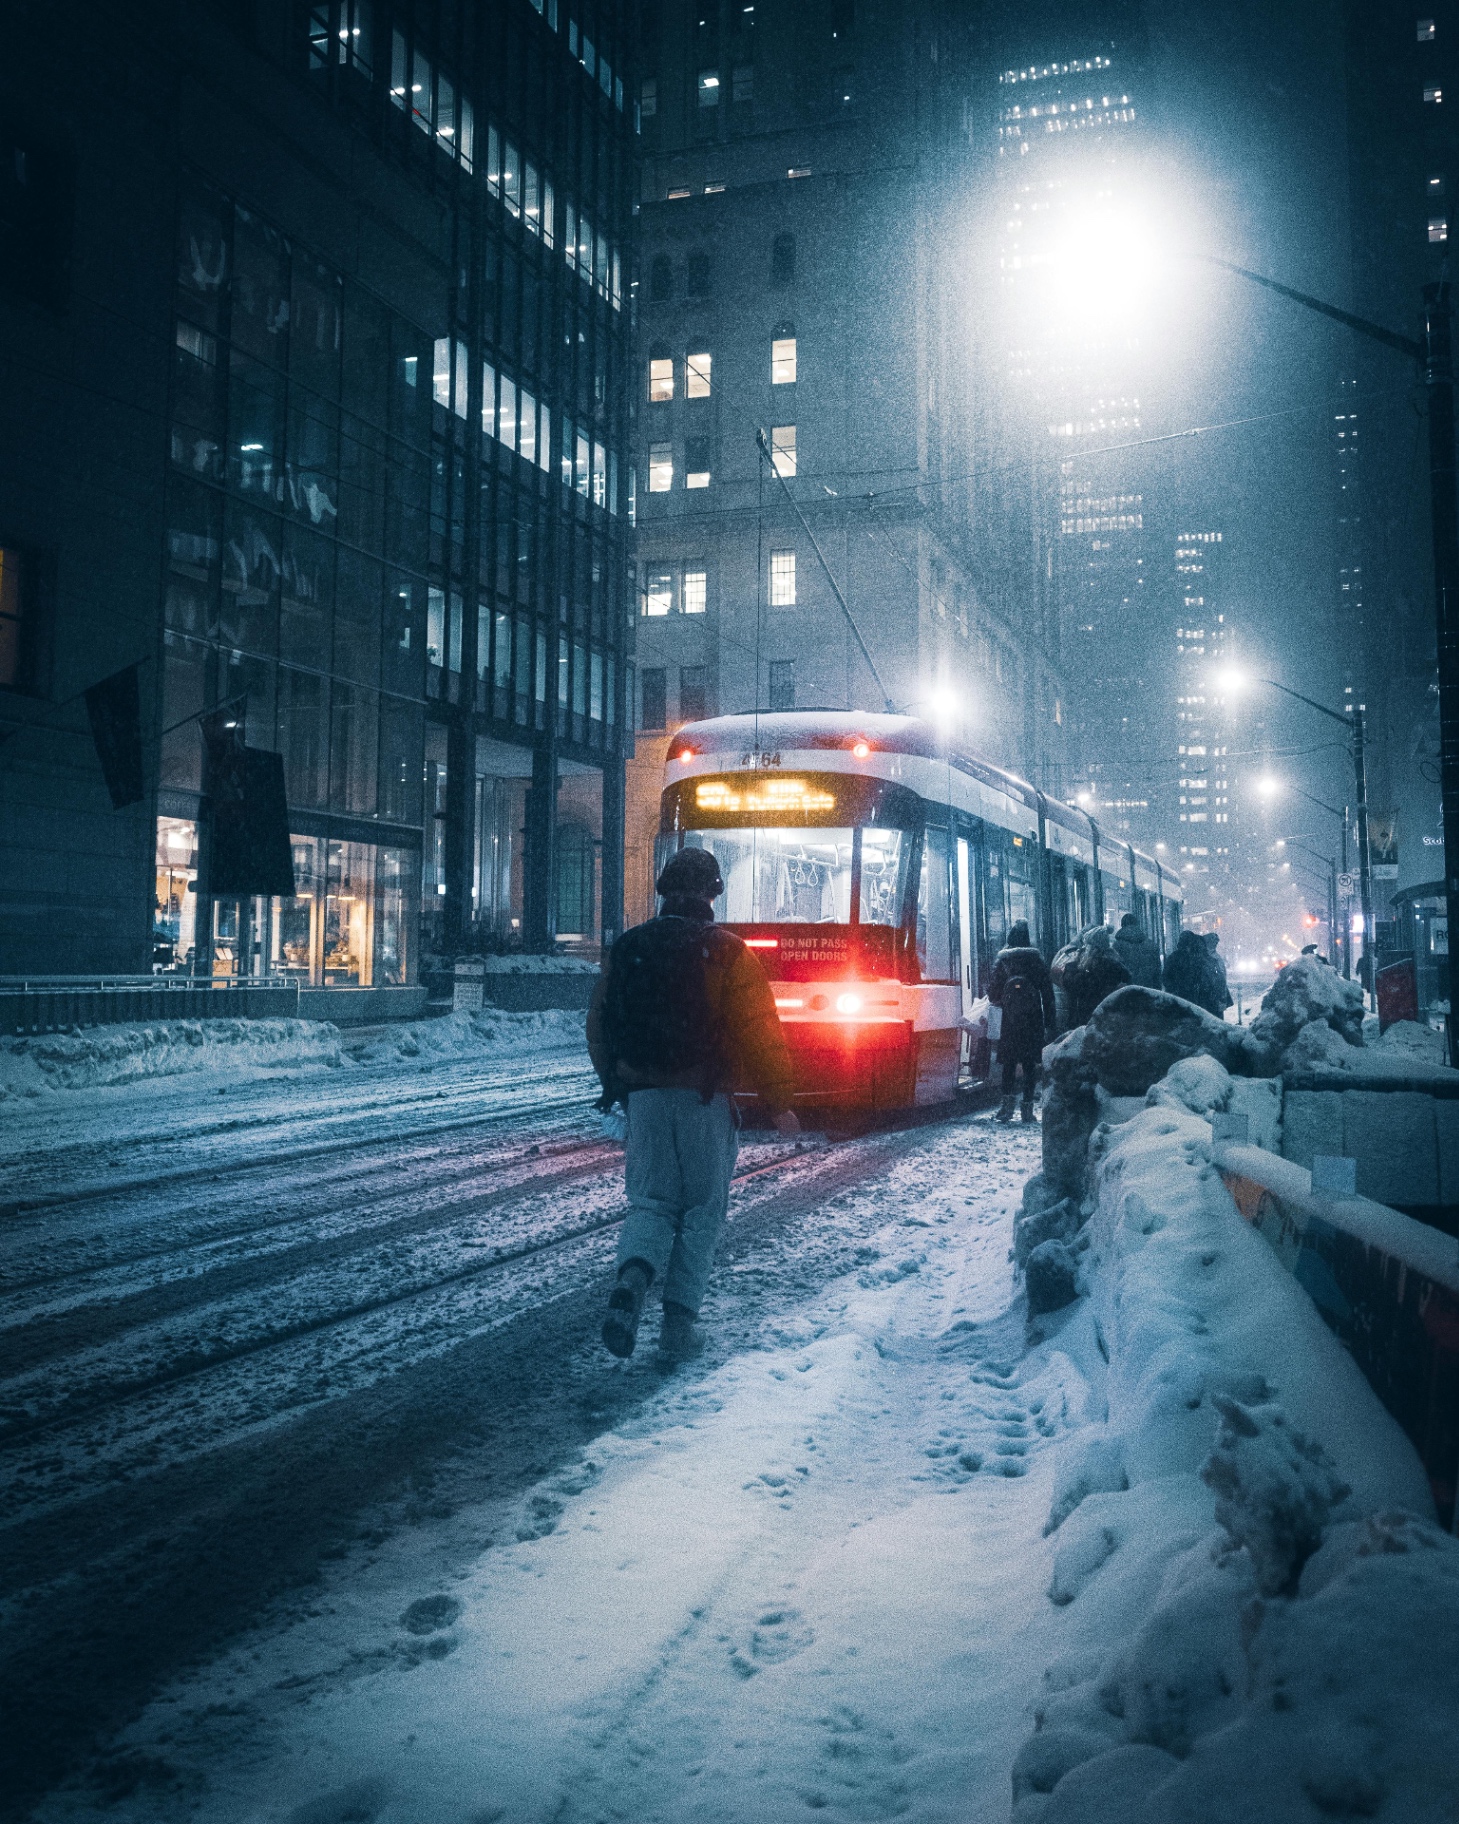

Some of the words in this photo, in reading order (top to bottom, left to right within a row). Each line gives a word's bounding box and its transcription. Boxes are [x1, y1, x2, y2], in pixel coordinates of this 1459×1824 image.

[781, 939, 795, 948] DO
[797, 939, 818, 948] NOT
[820, 938, 848, 949] PASS
[781, 951, 809, 961] OPEN
[812, 951, 848, 961] DOORS
